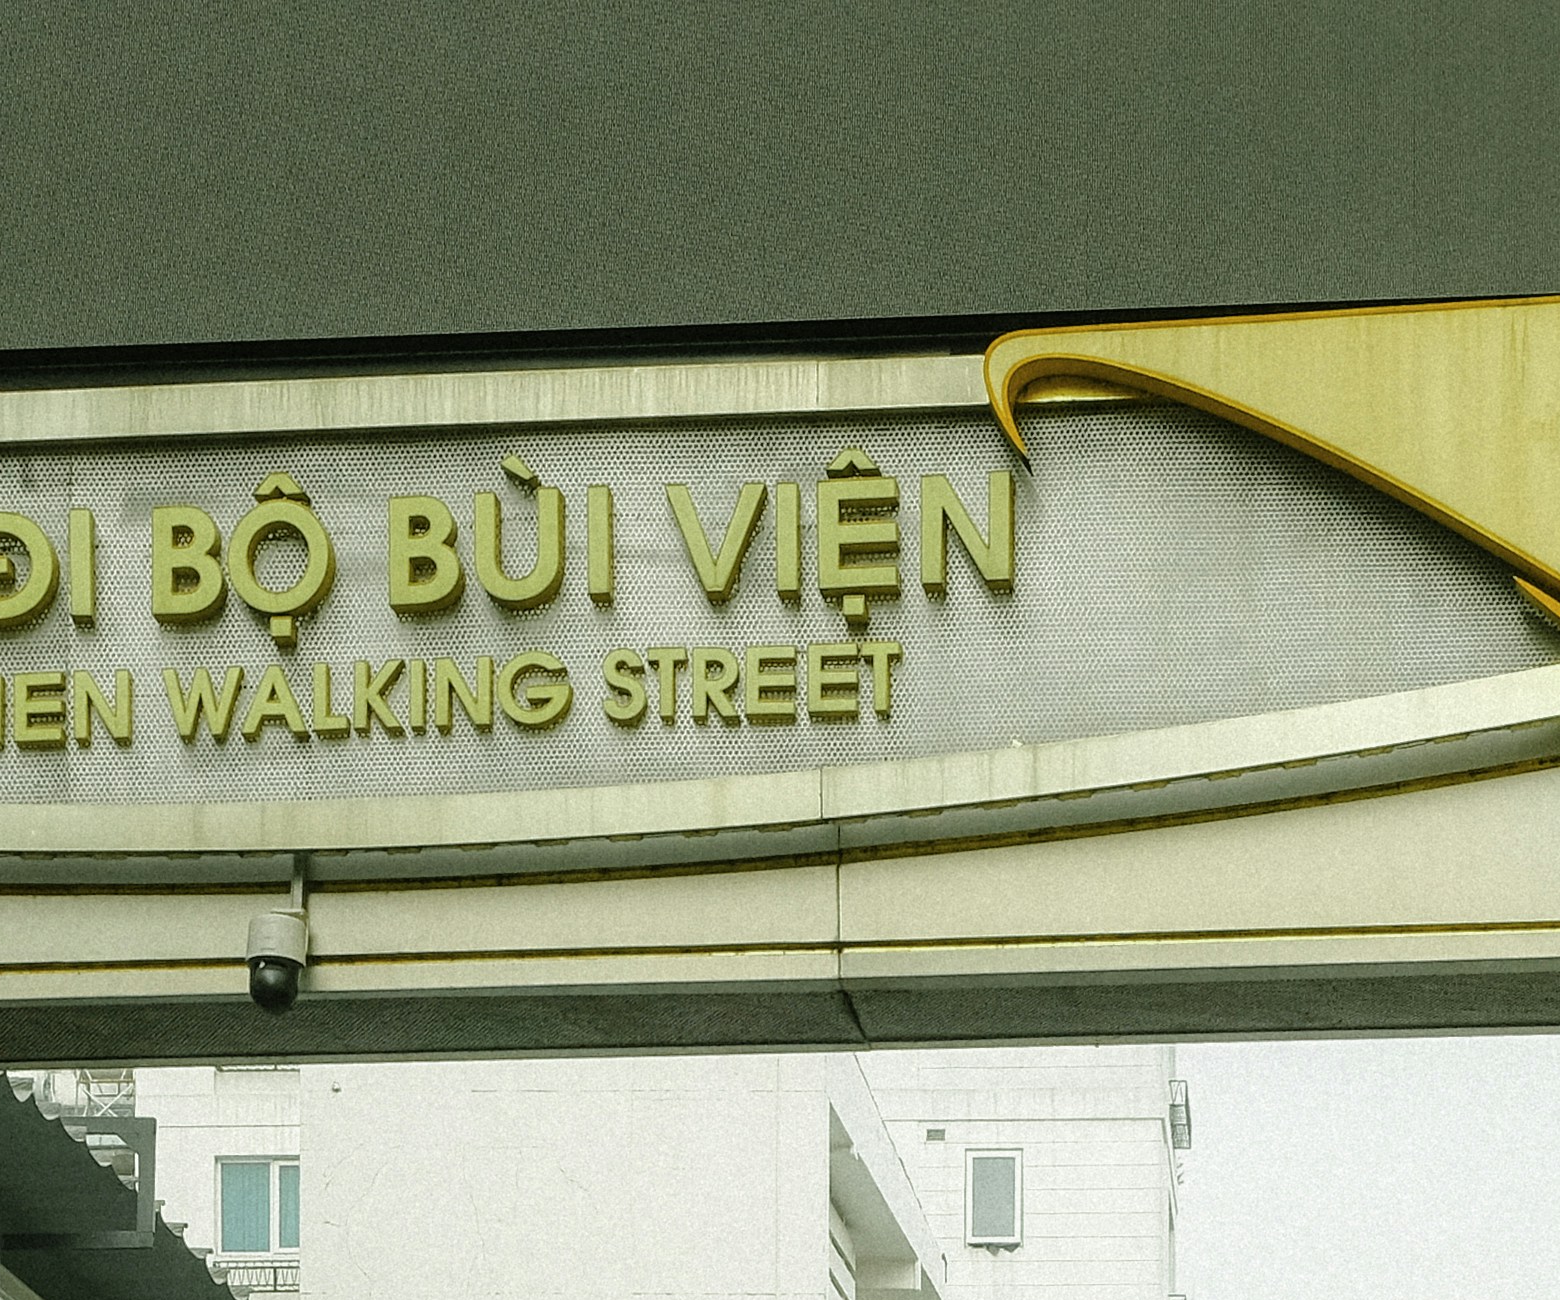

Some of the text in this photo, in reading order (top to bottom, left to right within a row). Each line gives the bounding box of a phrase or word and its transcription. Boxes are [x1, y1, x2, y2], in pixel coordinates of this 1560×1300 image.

[151, 470, 334, 648] BỘ
[388, 452, 616, 618] BÙI
[666, 446, 1017, 630] VIỆN
[163, 648, 574, 745] WALKING
[603, 640, 905, 728] STREET
